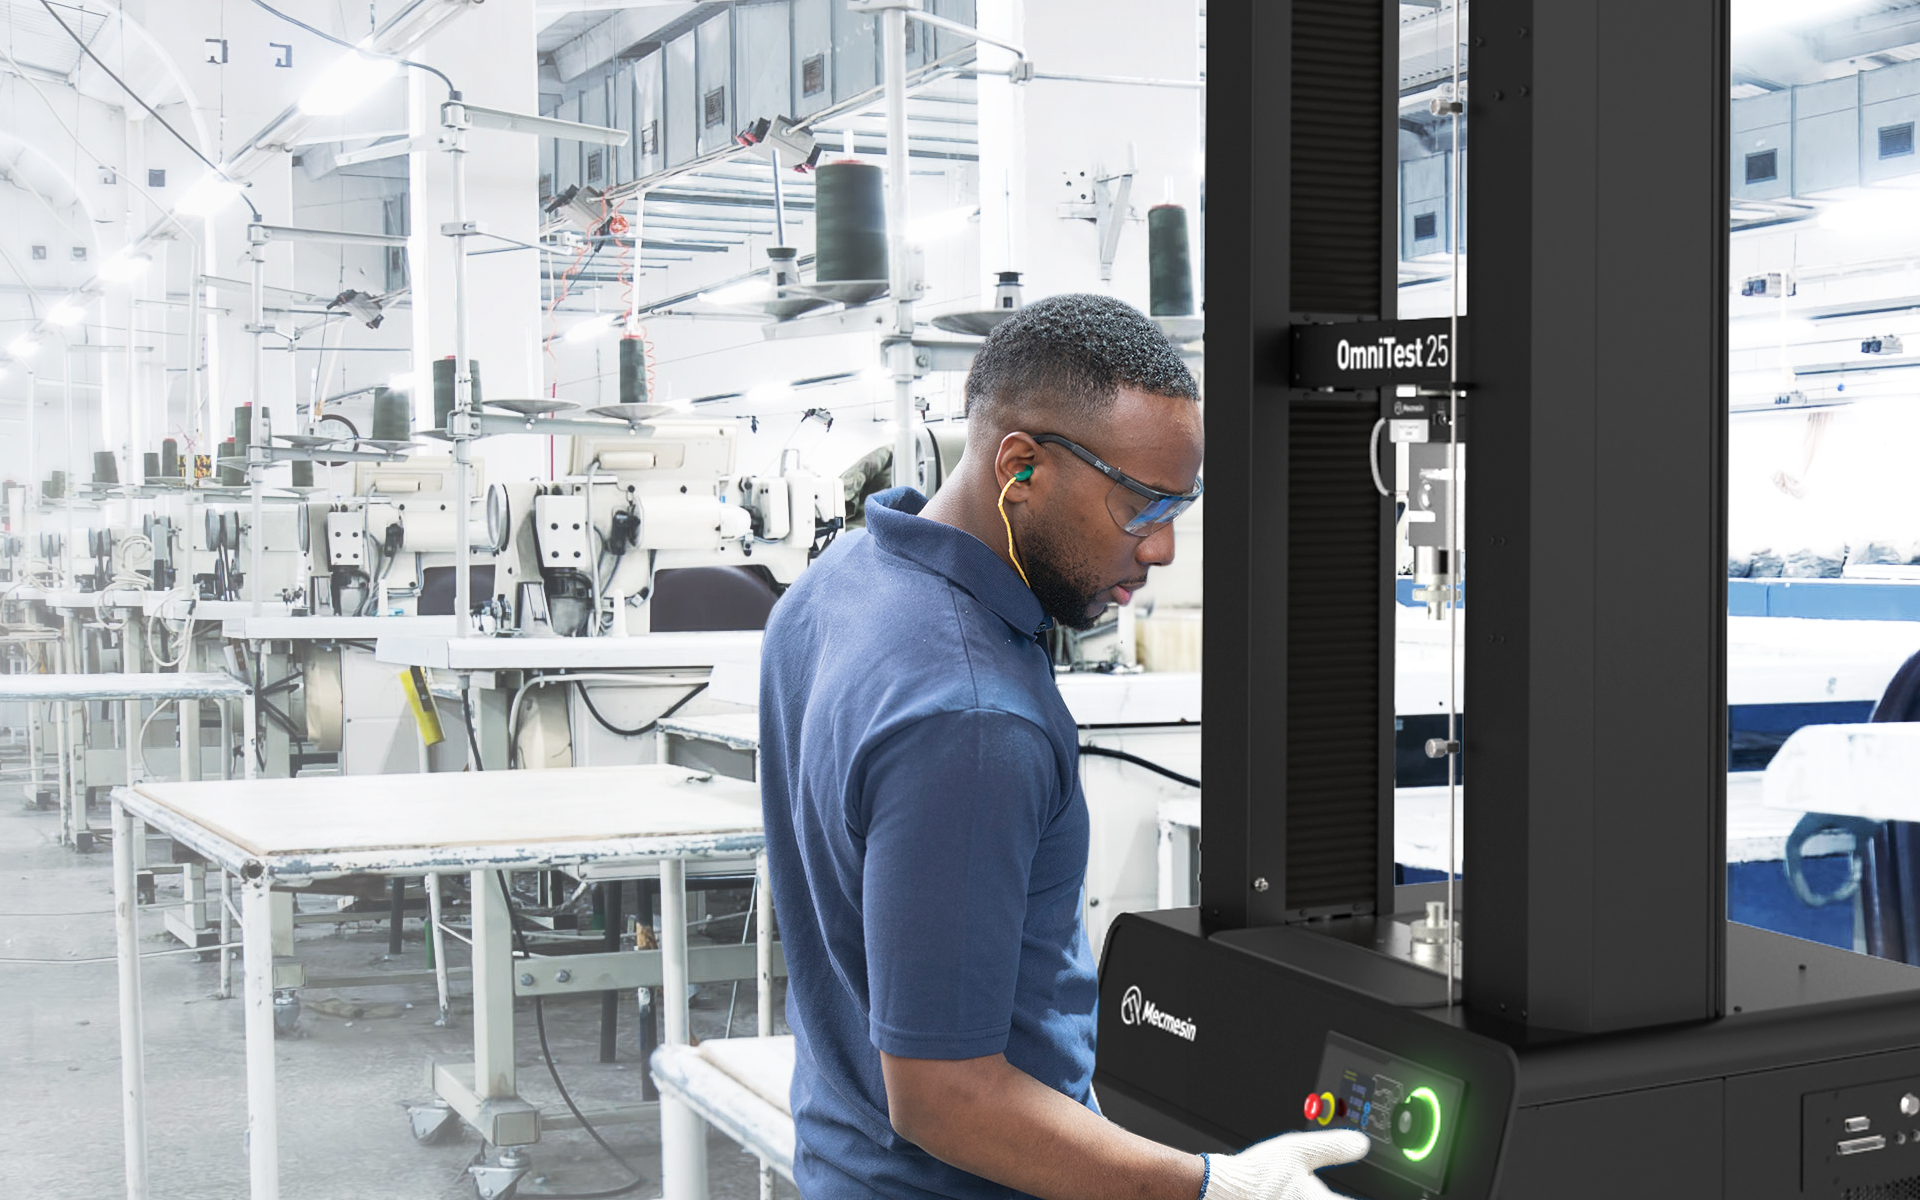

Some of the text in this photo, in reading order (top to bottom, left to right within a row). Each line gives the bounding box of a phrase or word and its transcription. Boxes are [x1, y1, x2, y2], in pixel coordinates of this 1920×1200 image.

[1337, 334, 1449, 370] OmniTest 25
[1141, 1000, 1197, 1042] Mecmesin
